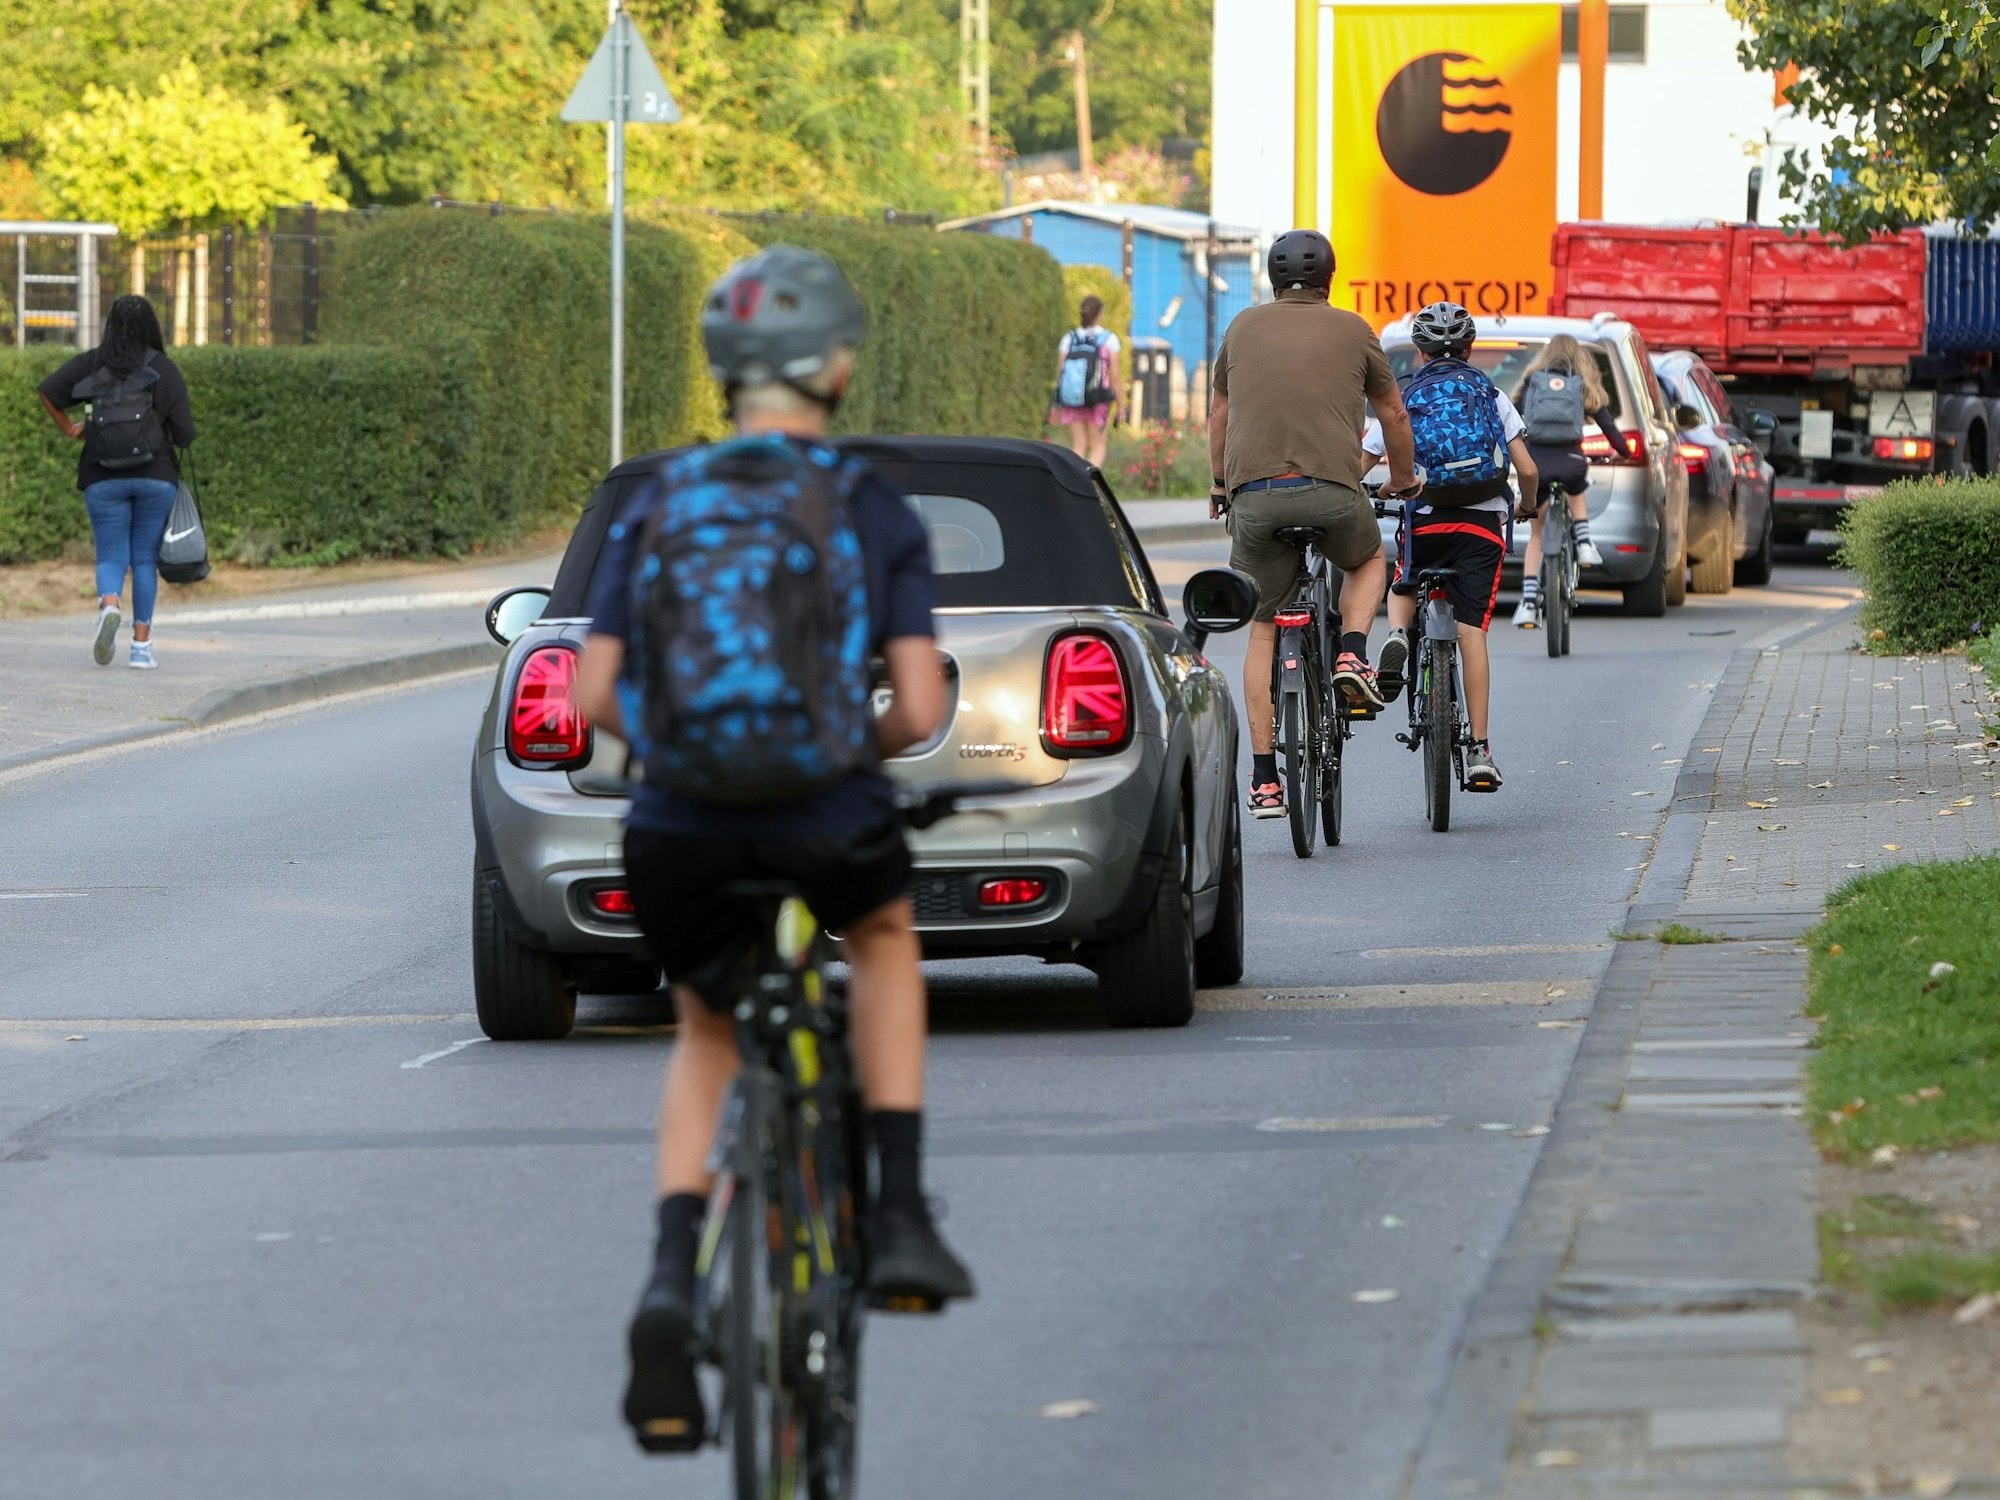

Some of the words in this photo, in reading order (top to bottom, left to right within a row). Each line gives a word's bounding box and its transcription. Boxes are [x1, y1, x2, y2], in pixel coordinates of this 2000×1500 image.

[1349, 281, 1538, 313] TRIOTOP
[1886, 394, 1917, 430] A
[960, 743, 1016, 758] COOPER
